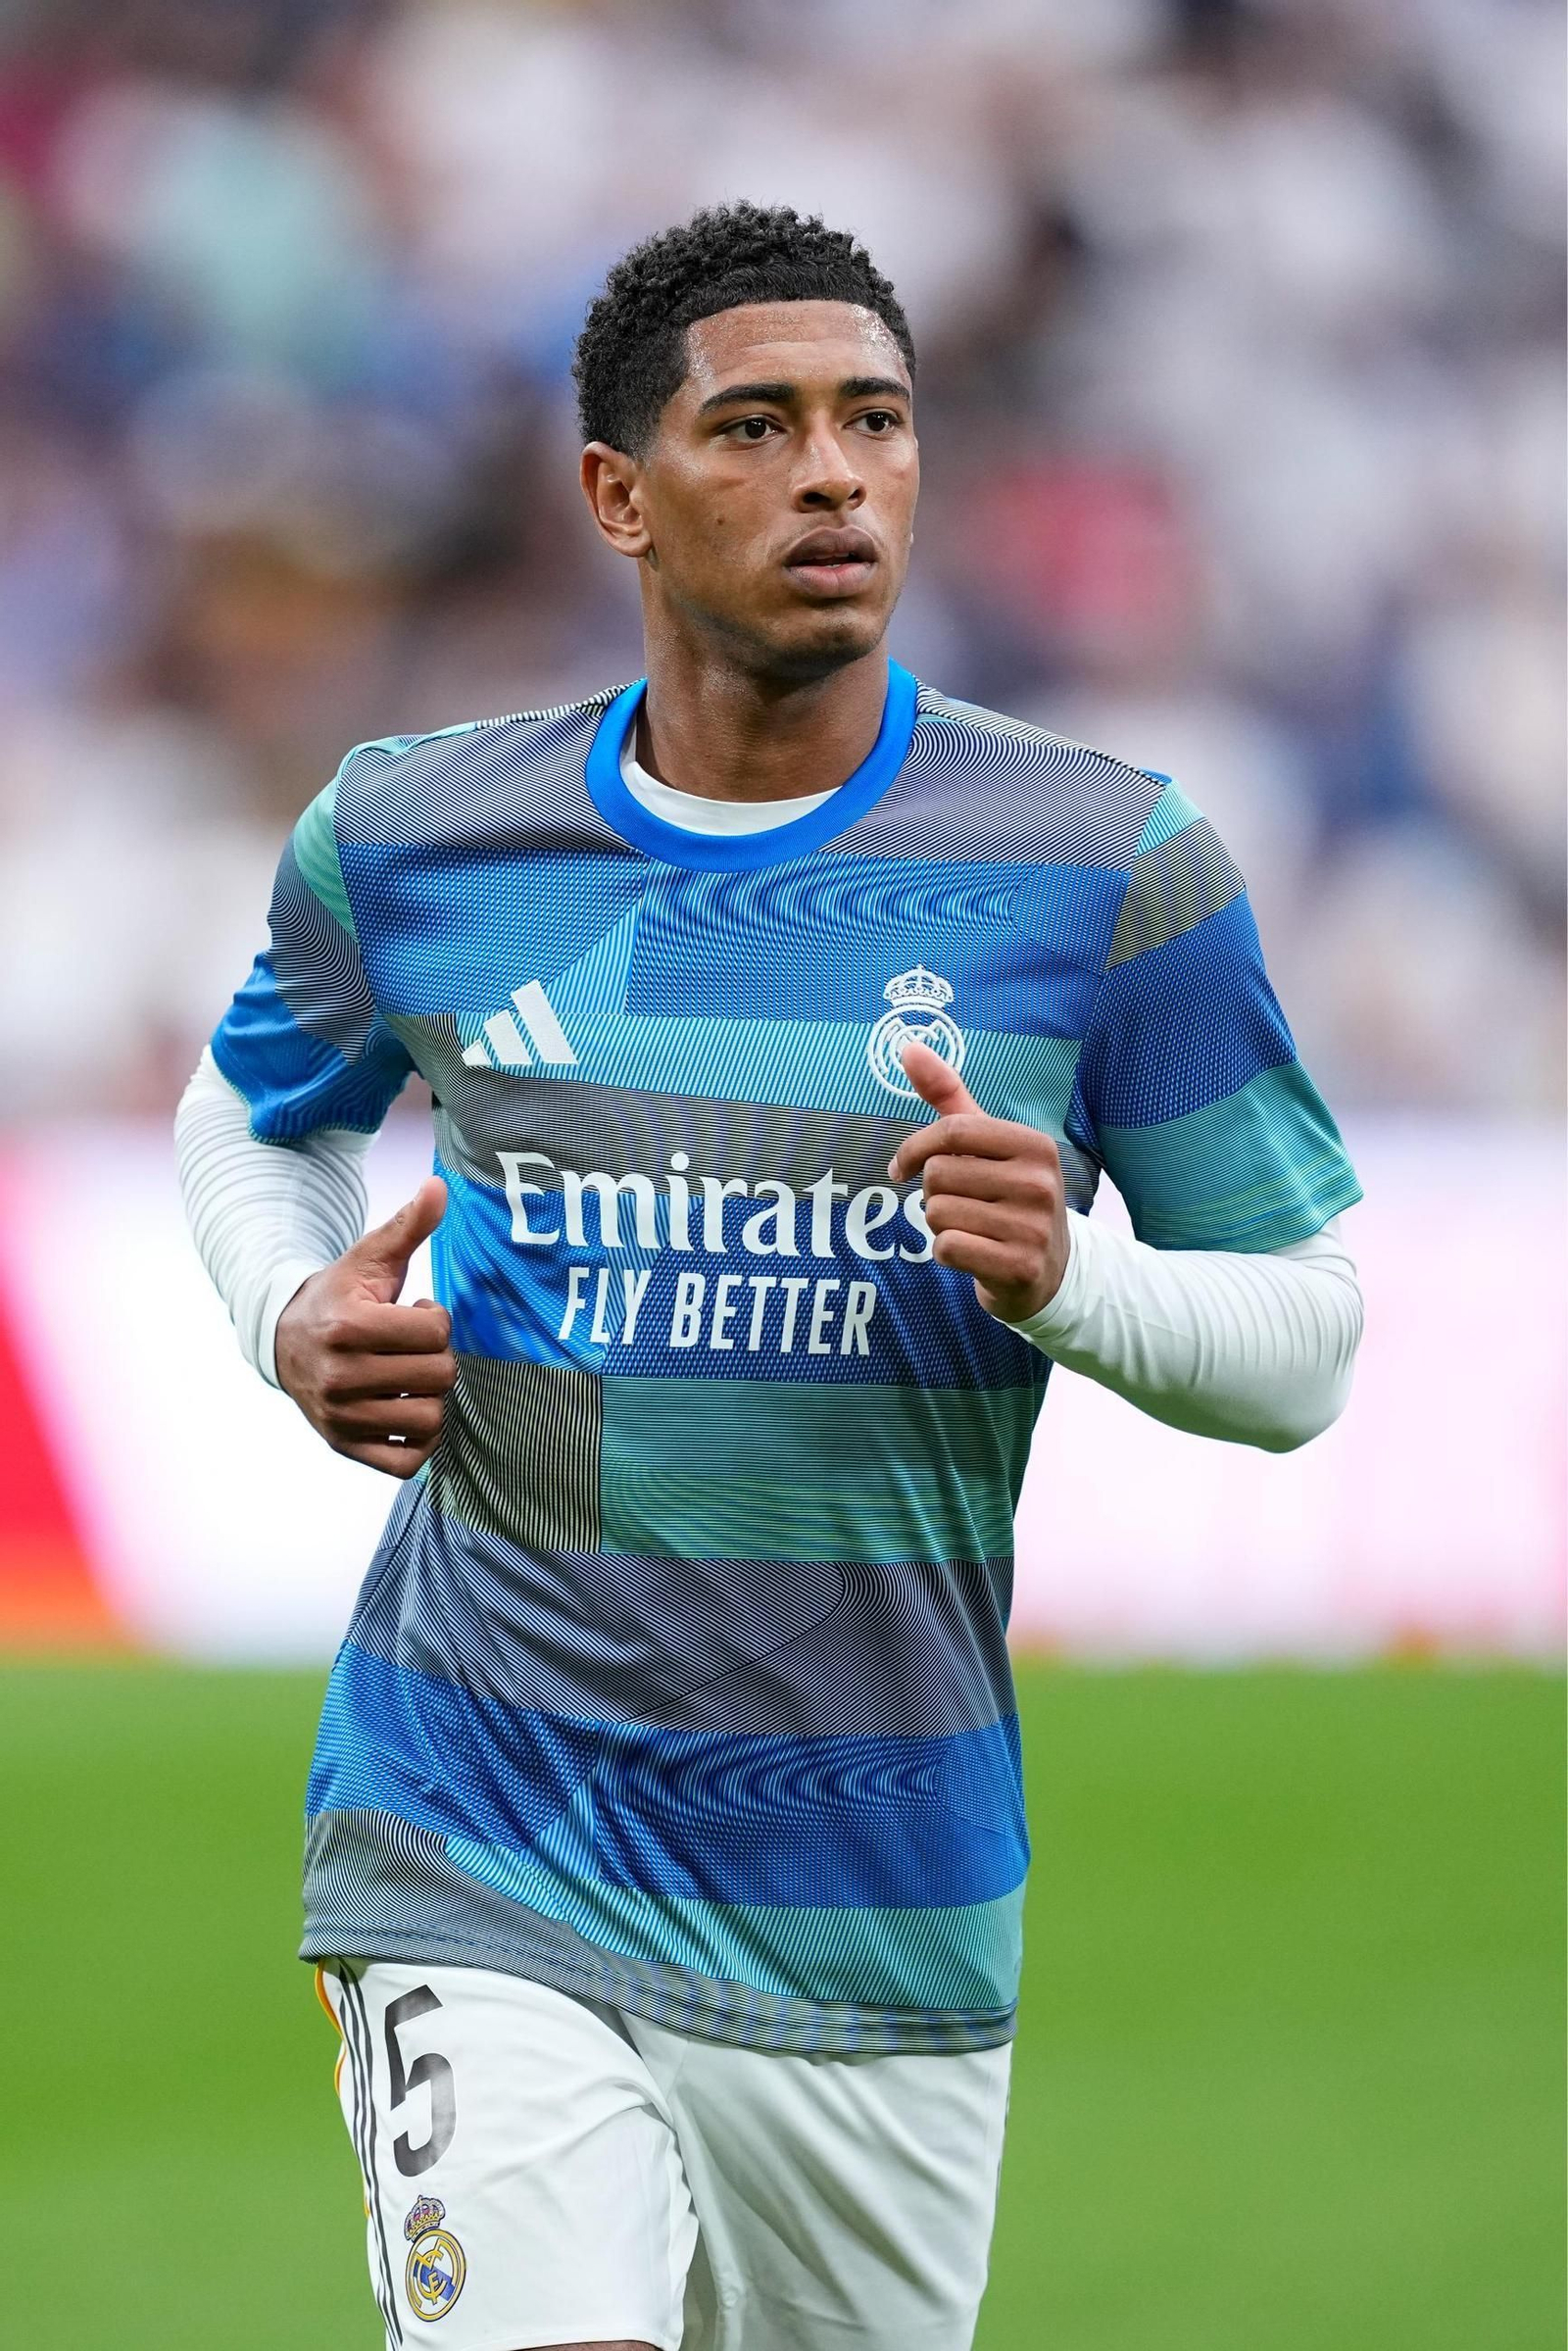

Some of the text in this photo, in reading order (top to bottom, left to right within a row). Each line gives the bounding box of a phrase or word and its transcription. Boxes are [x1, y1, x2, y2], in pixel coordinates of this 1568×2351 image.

[495, 1151, 936, 1263] Emirates
[559, 1266, 877, 1355] FLY BETTER
[384, 1984, 457, 2178] 5
